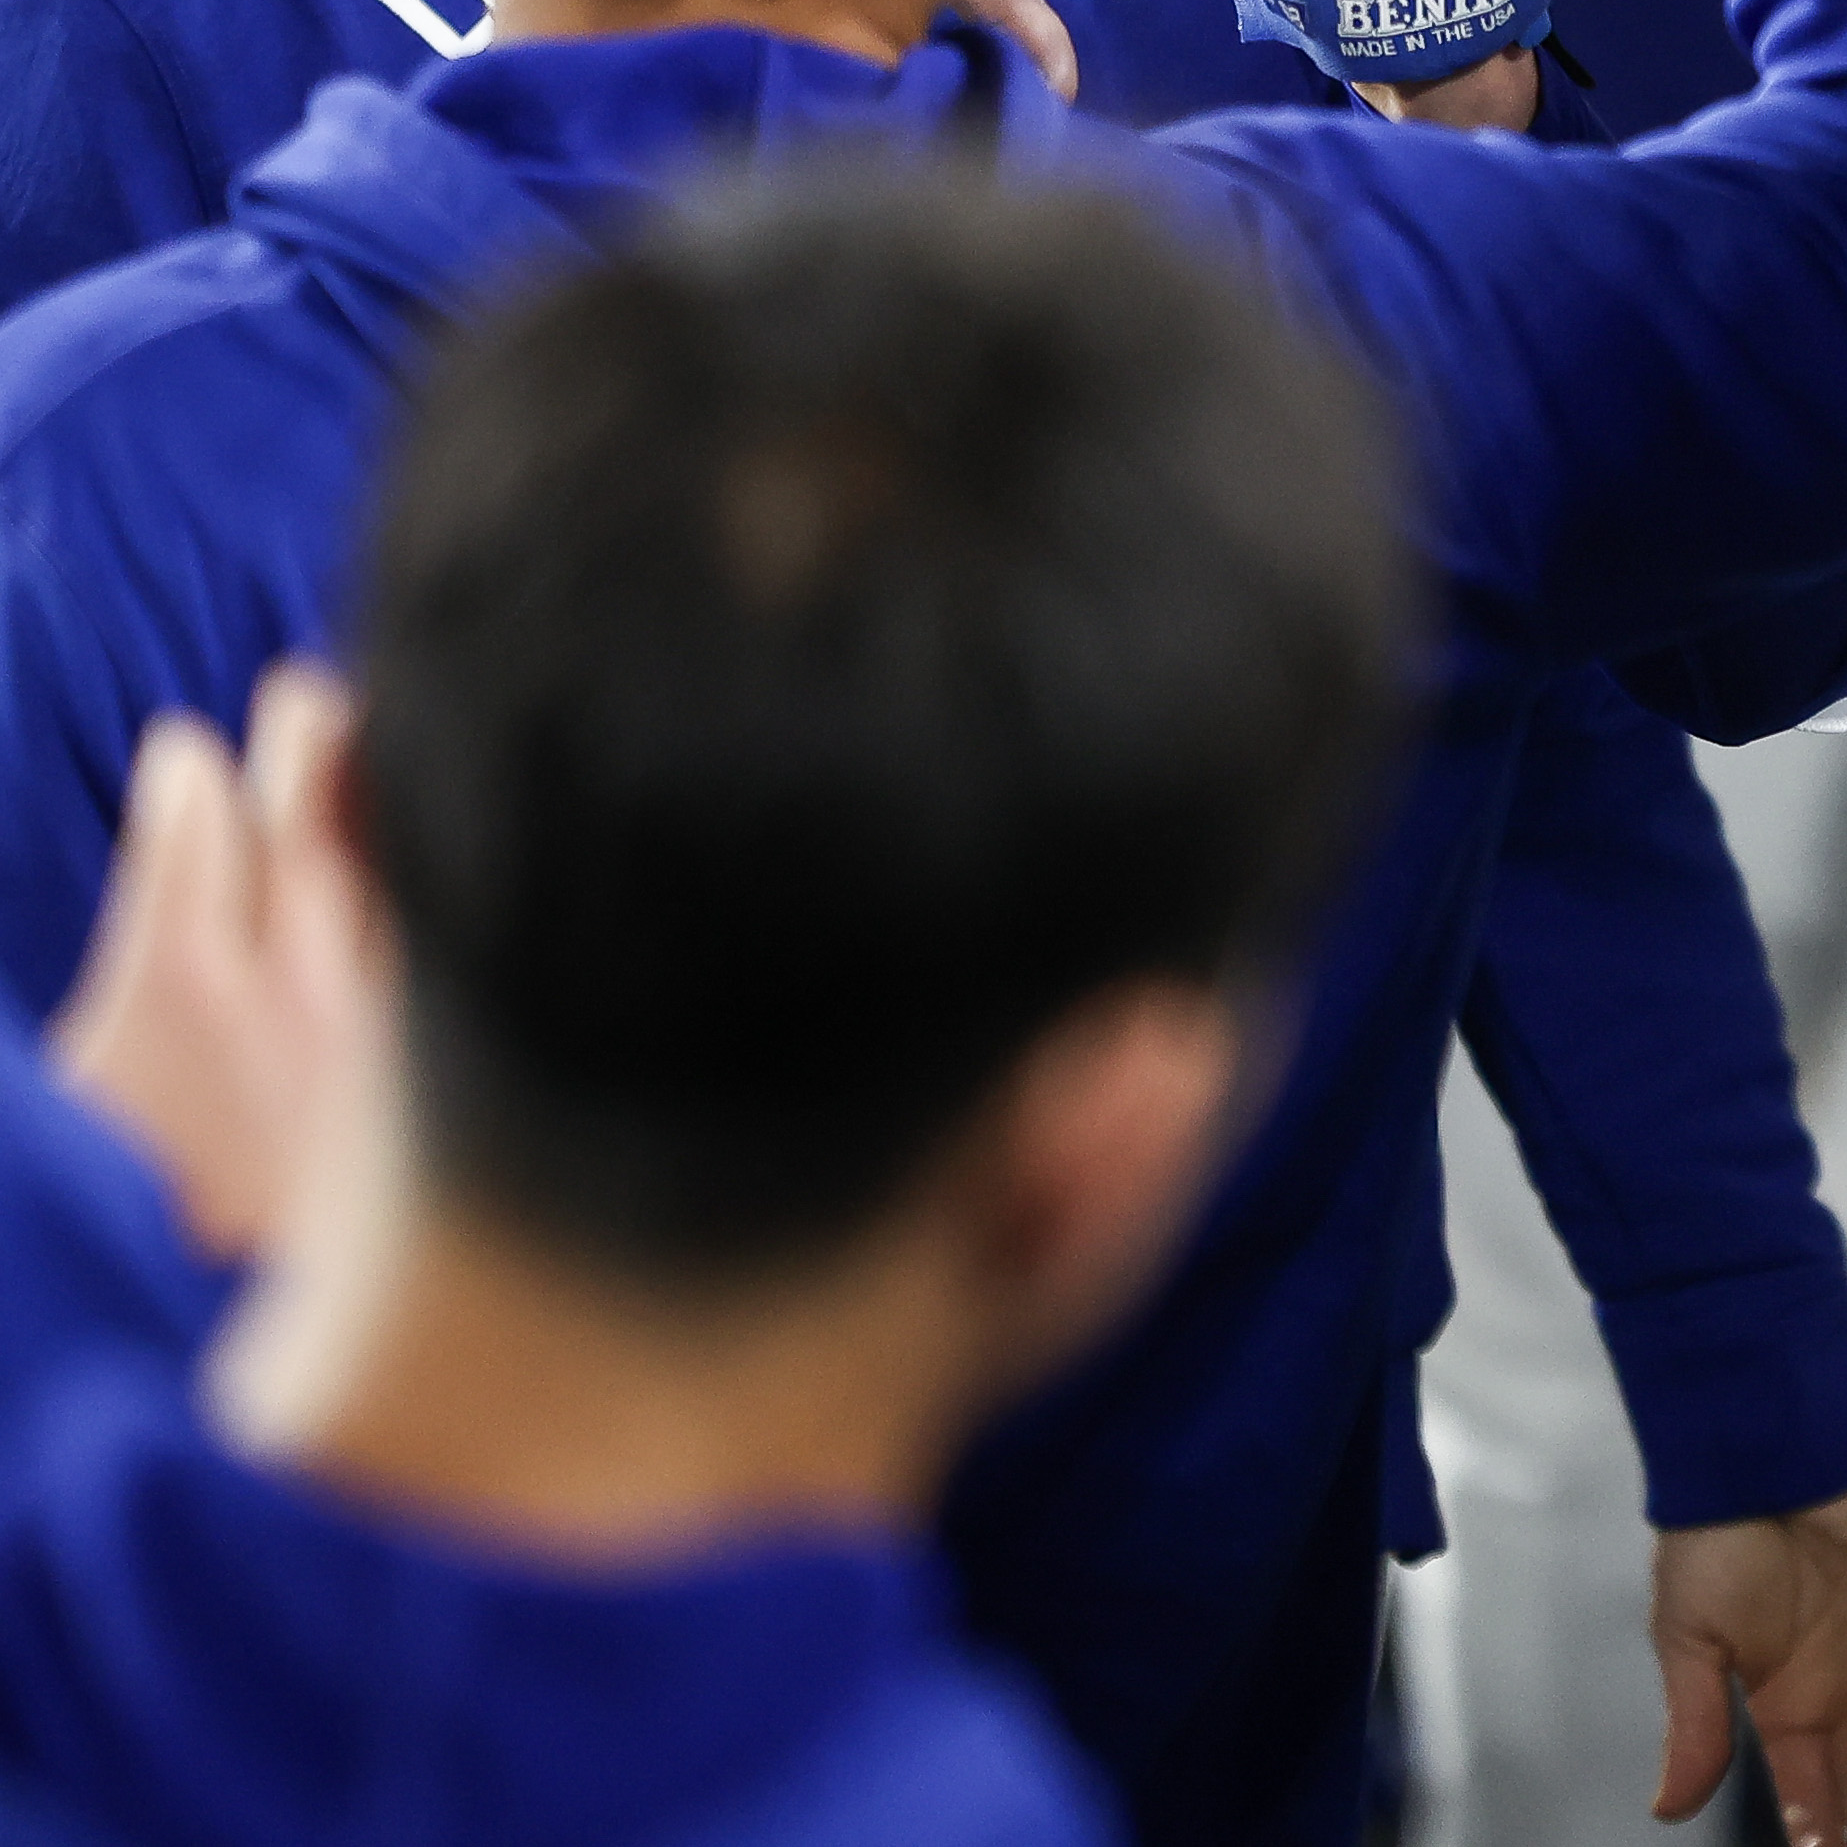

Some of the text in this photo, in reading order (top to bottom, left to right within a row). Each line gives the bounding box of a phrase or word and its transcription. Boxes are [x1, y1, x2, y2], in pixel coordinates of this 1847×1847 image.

[1340, 3, 1516, 57] MADE IN THE USA
